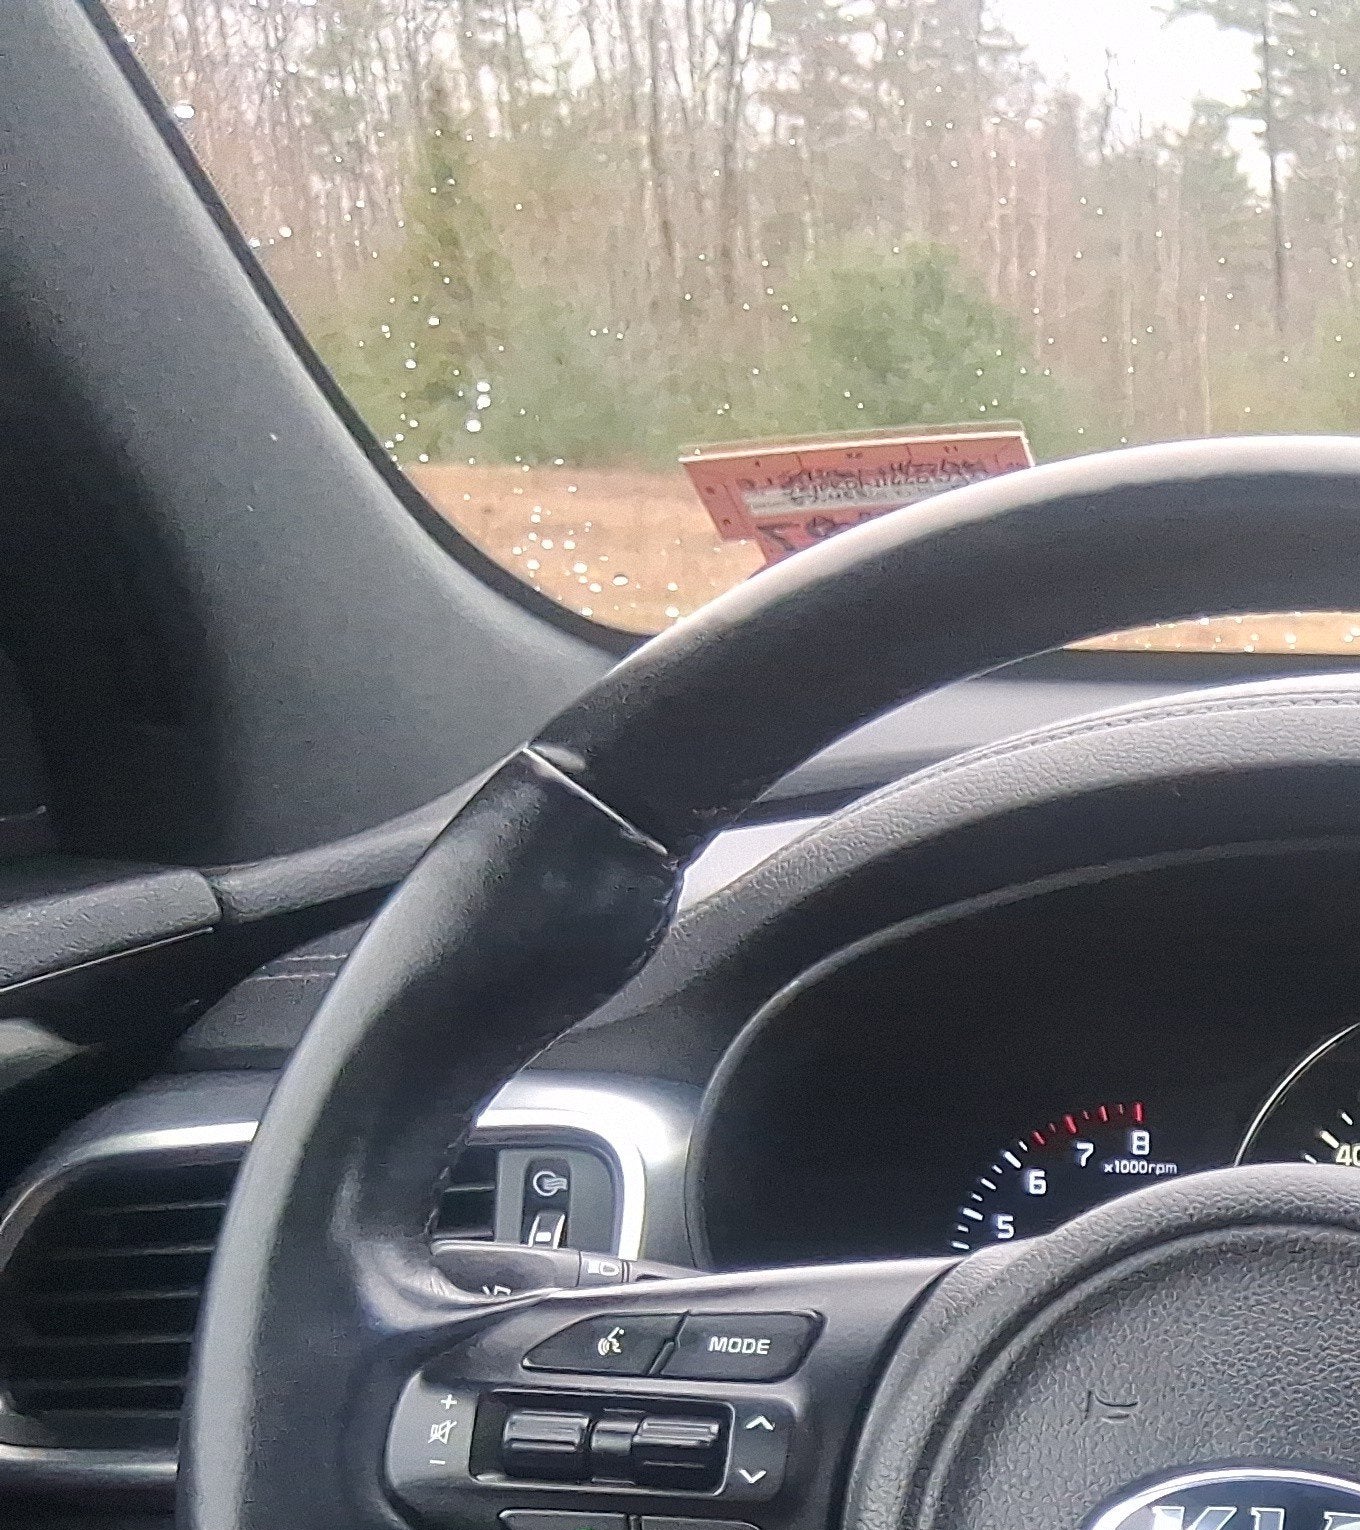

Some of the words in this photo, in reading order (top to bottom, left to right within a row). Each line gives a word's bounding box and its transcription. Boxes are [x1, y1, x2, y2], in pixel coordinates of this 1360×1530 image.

[1076, 1142, 1094, 1167] 7
[1130, 1130, 1150, 1155] 8
[1103, 1160, 1178, 1176] x1000rpm
[1028, 1169, 1047, 1195] 6
[996, 1215, 1014, 1239] 5
[707, 1336, 771, 1356] MODE
